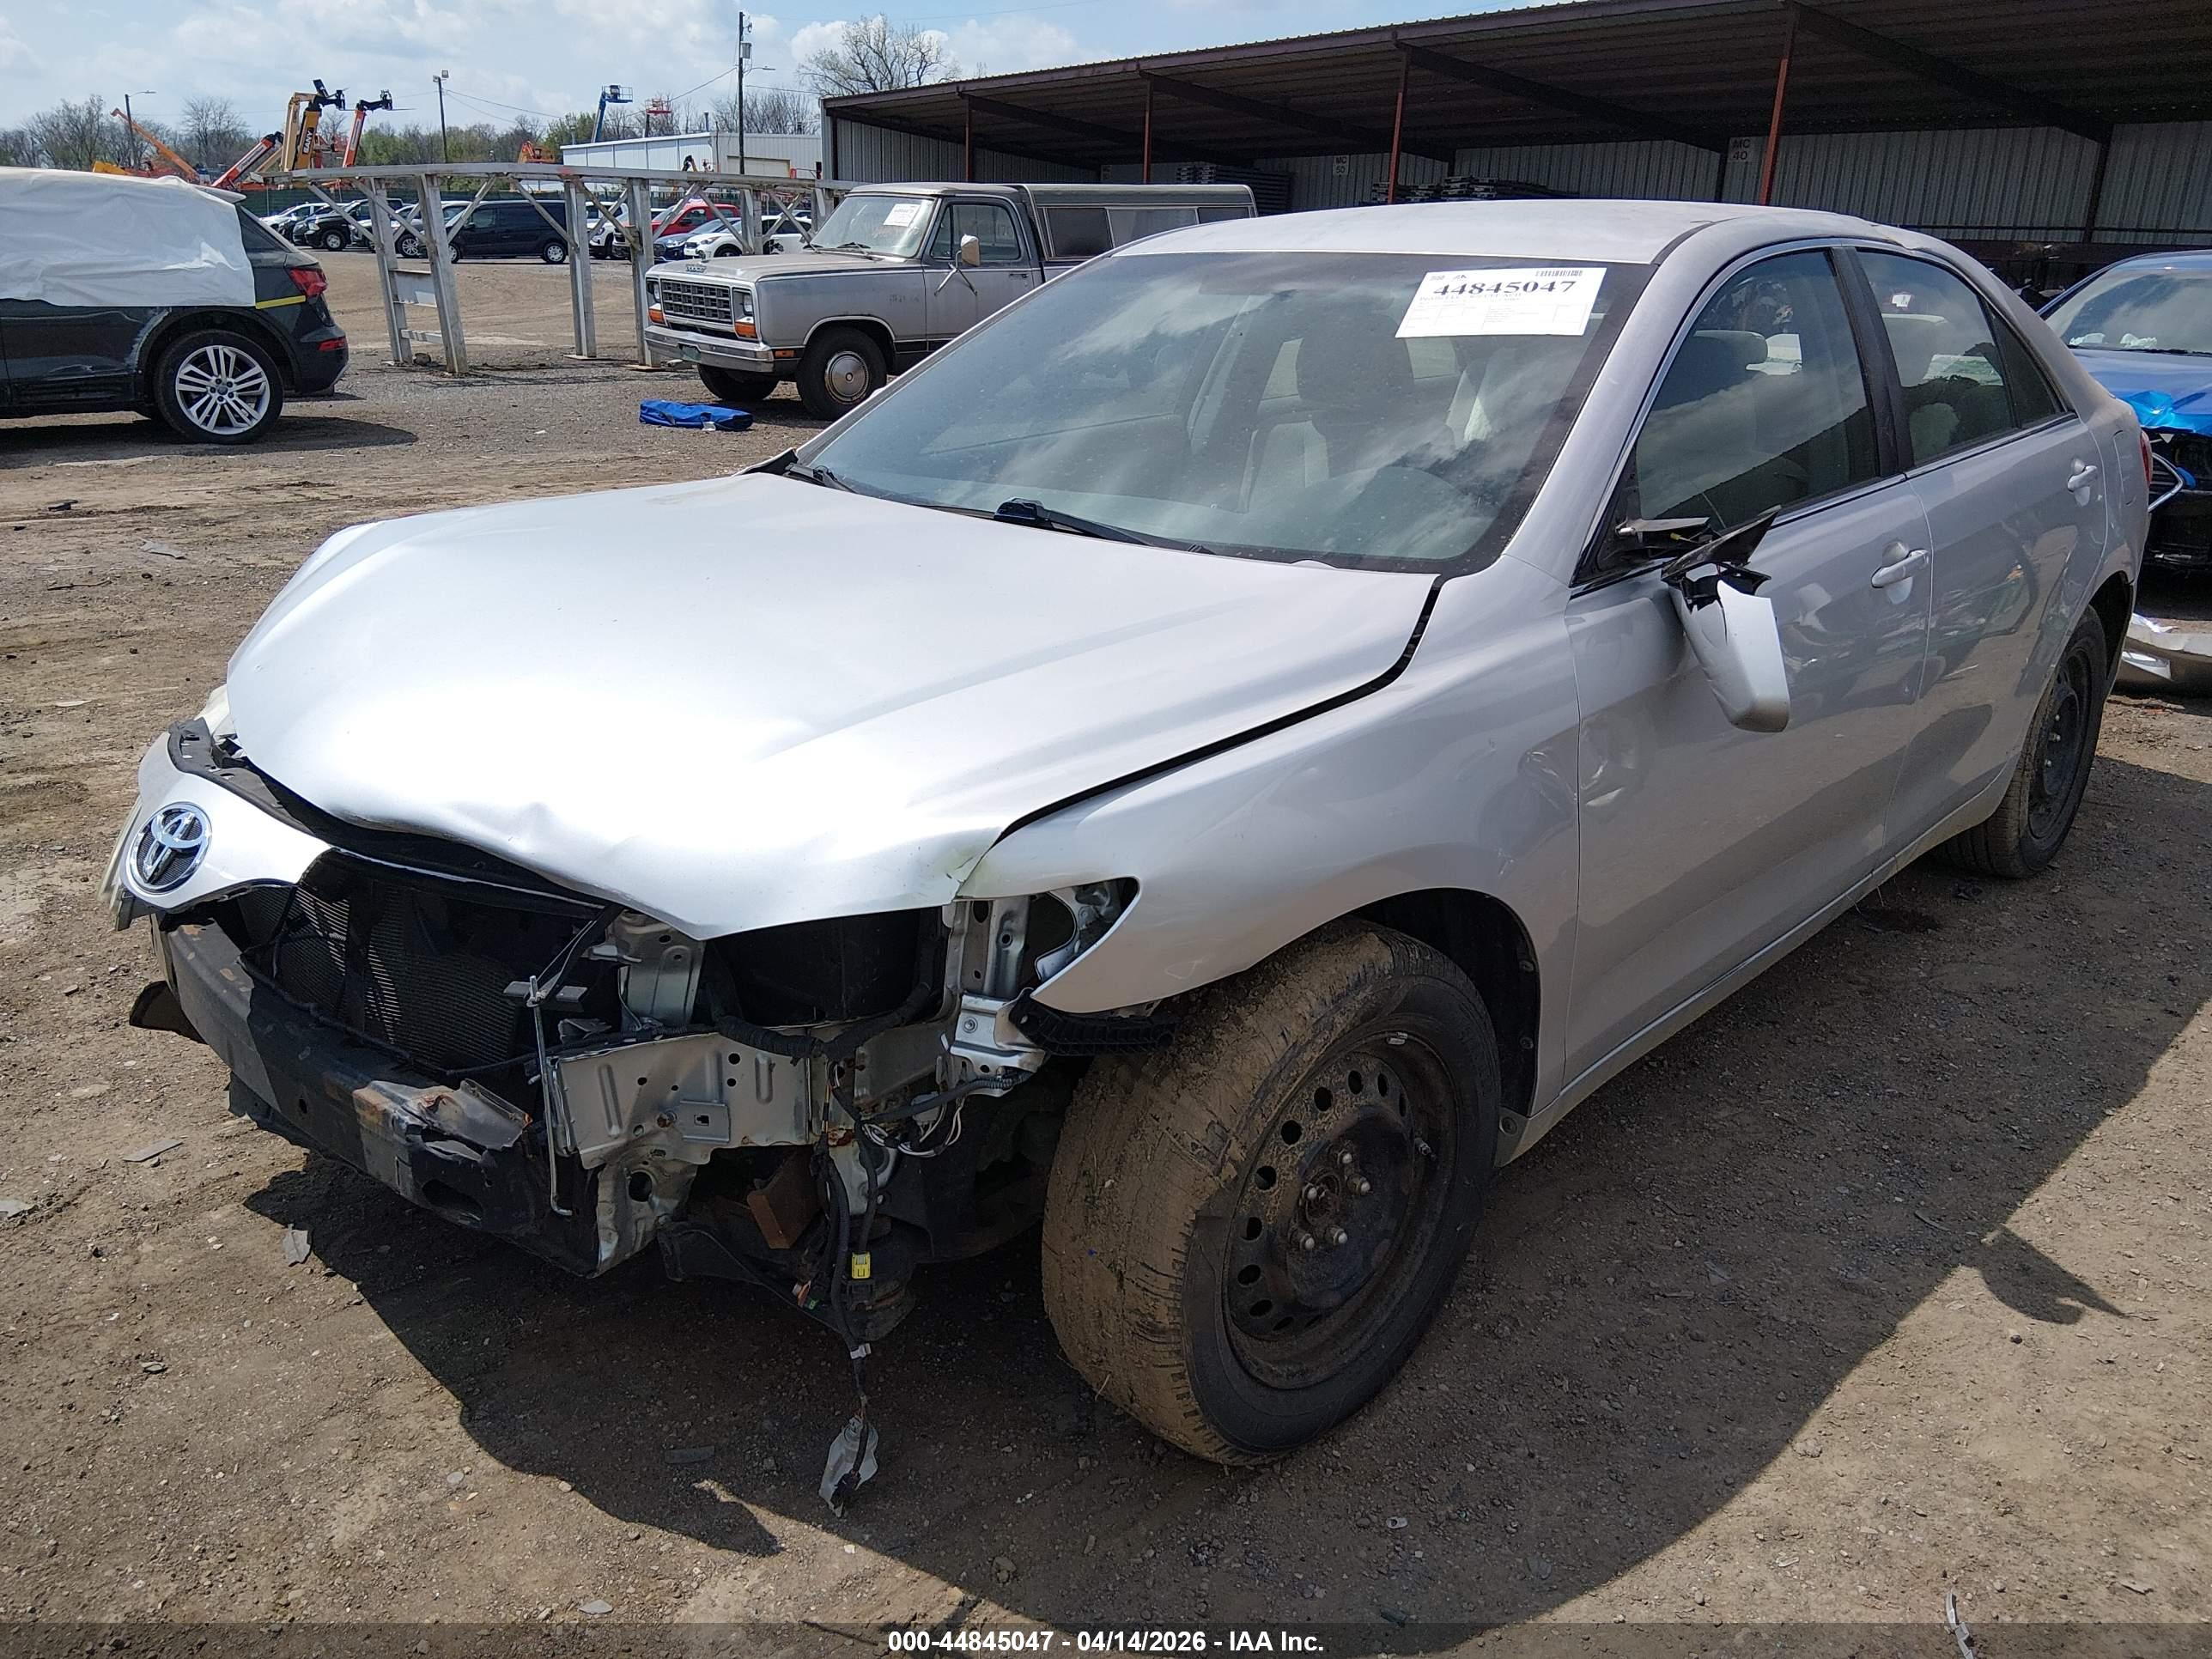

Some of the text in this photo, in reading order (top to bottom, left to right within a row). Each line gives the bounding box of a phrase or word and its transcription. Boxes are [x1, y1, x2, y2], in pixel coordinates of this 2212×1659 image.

[303, 131, 313, 153] SANY
[1733, 151, 1747, 160] 40
[1433, 281, 1577, 296] 44845047
